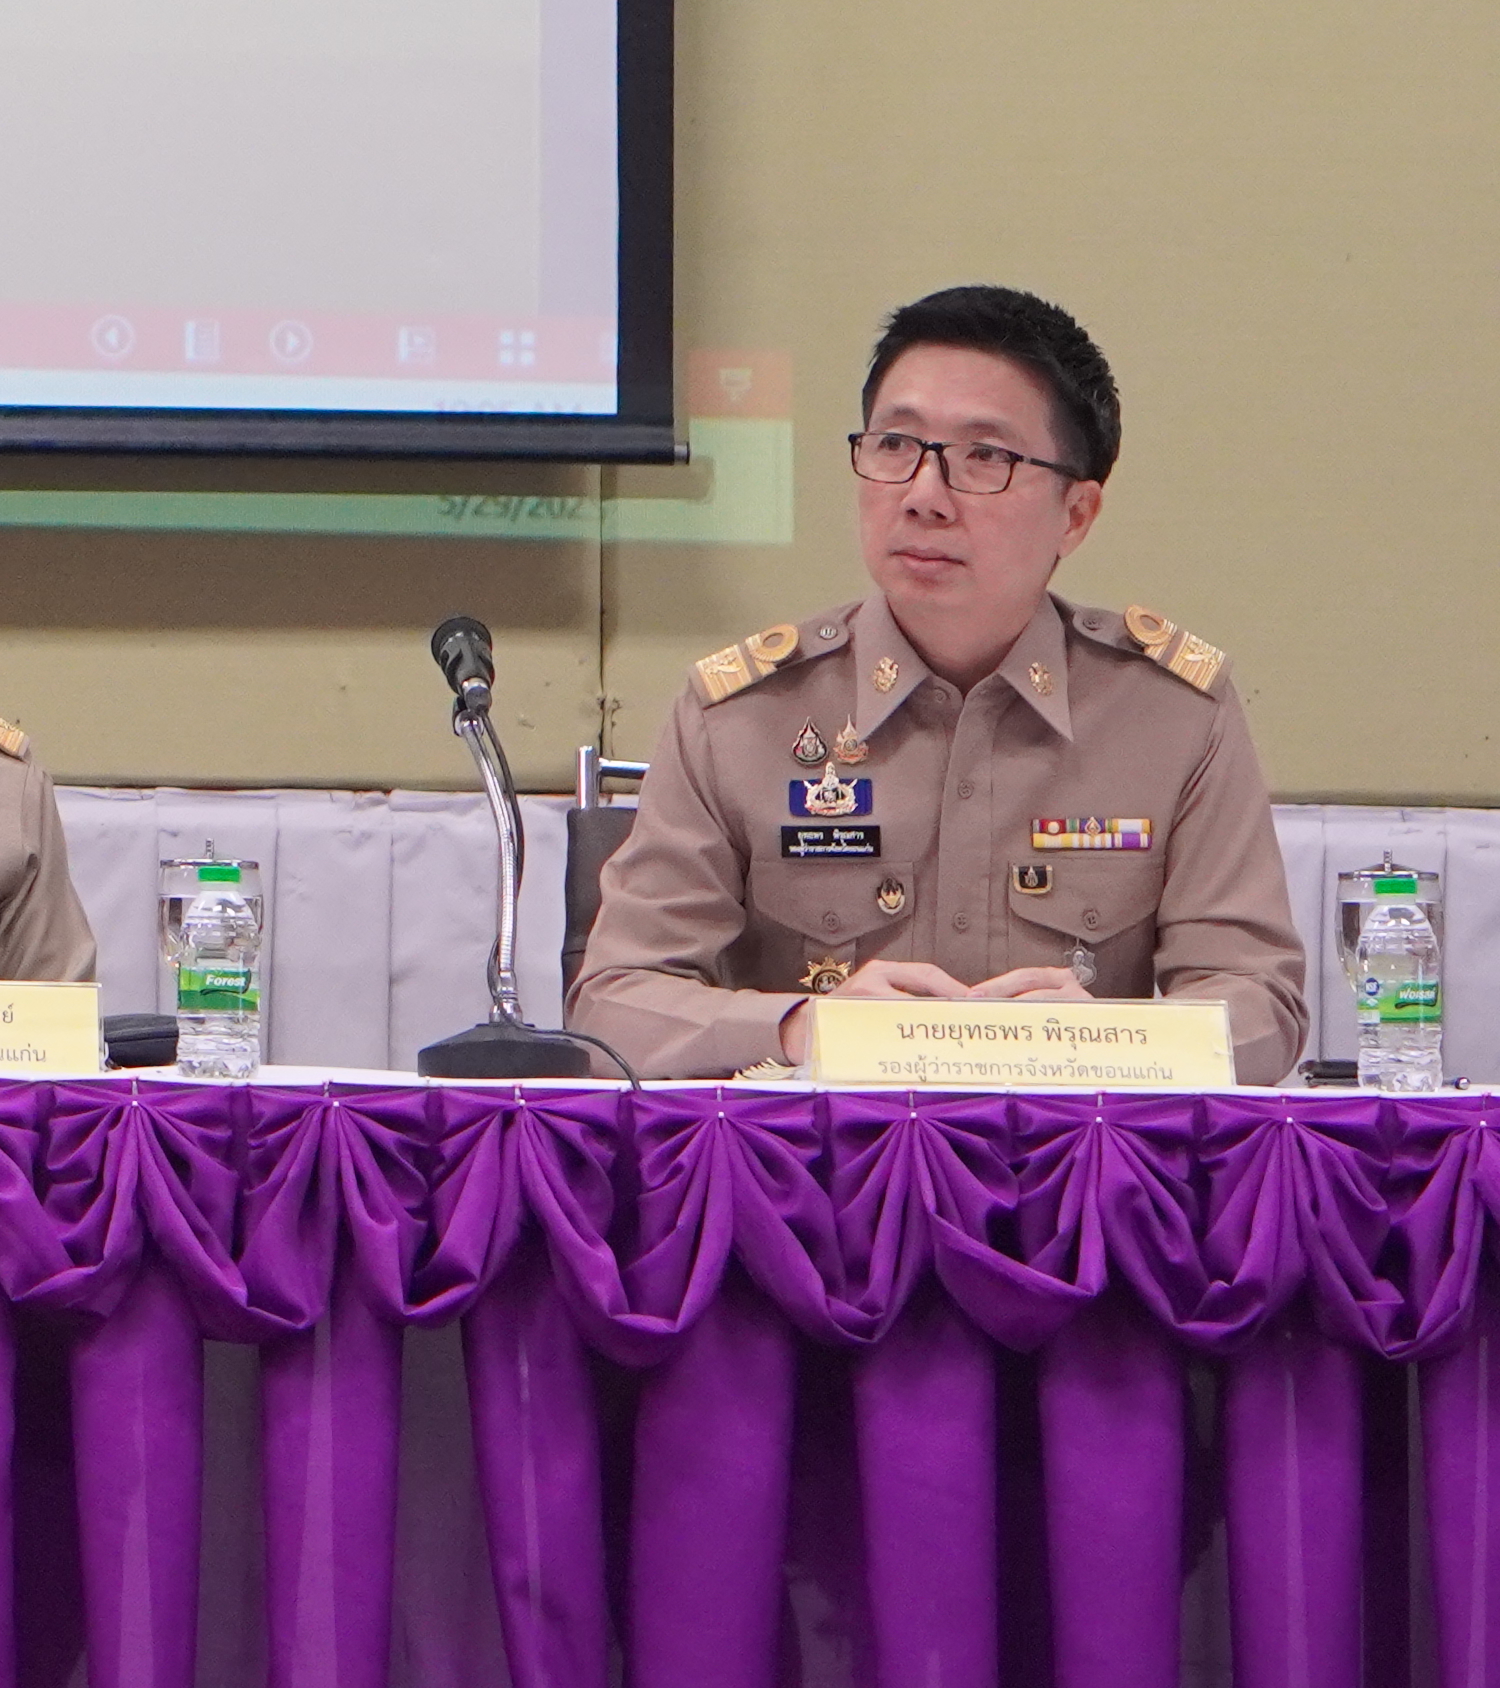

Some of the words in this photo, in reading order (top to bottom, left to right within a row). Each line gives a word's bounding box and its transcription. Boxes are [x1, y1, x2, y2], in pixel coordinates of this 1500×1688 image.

[205, 973, 246, 987] Forest
[896, 1020, 1034, 1048] นายยุทธพร
[1042, 1017, 1149, 1050] พิรุณสาร
[877, 1052, 1175, 1084] รองผู้ว่าราชการจังหวัดขอนแก่น
